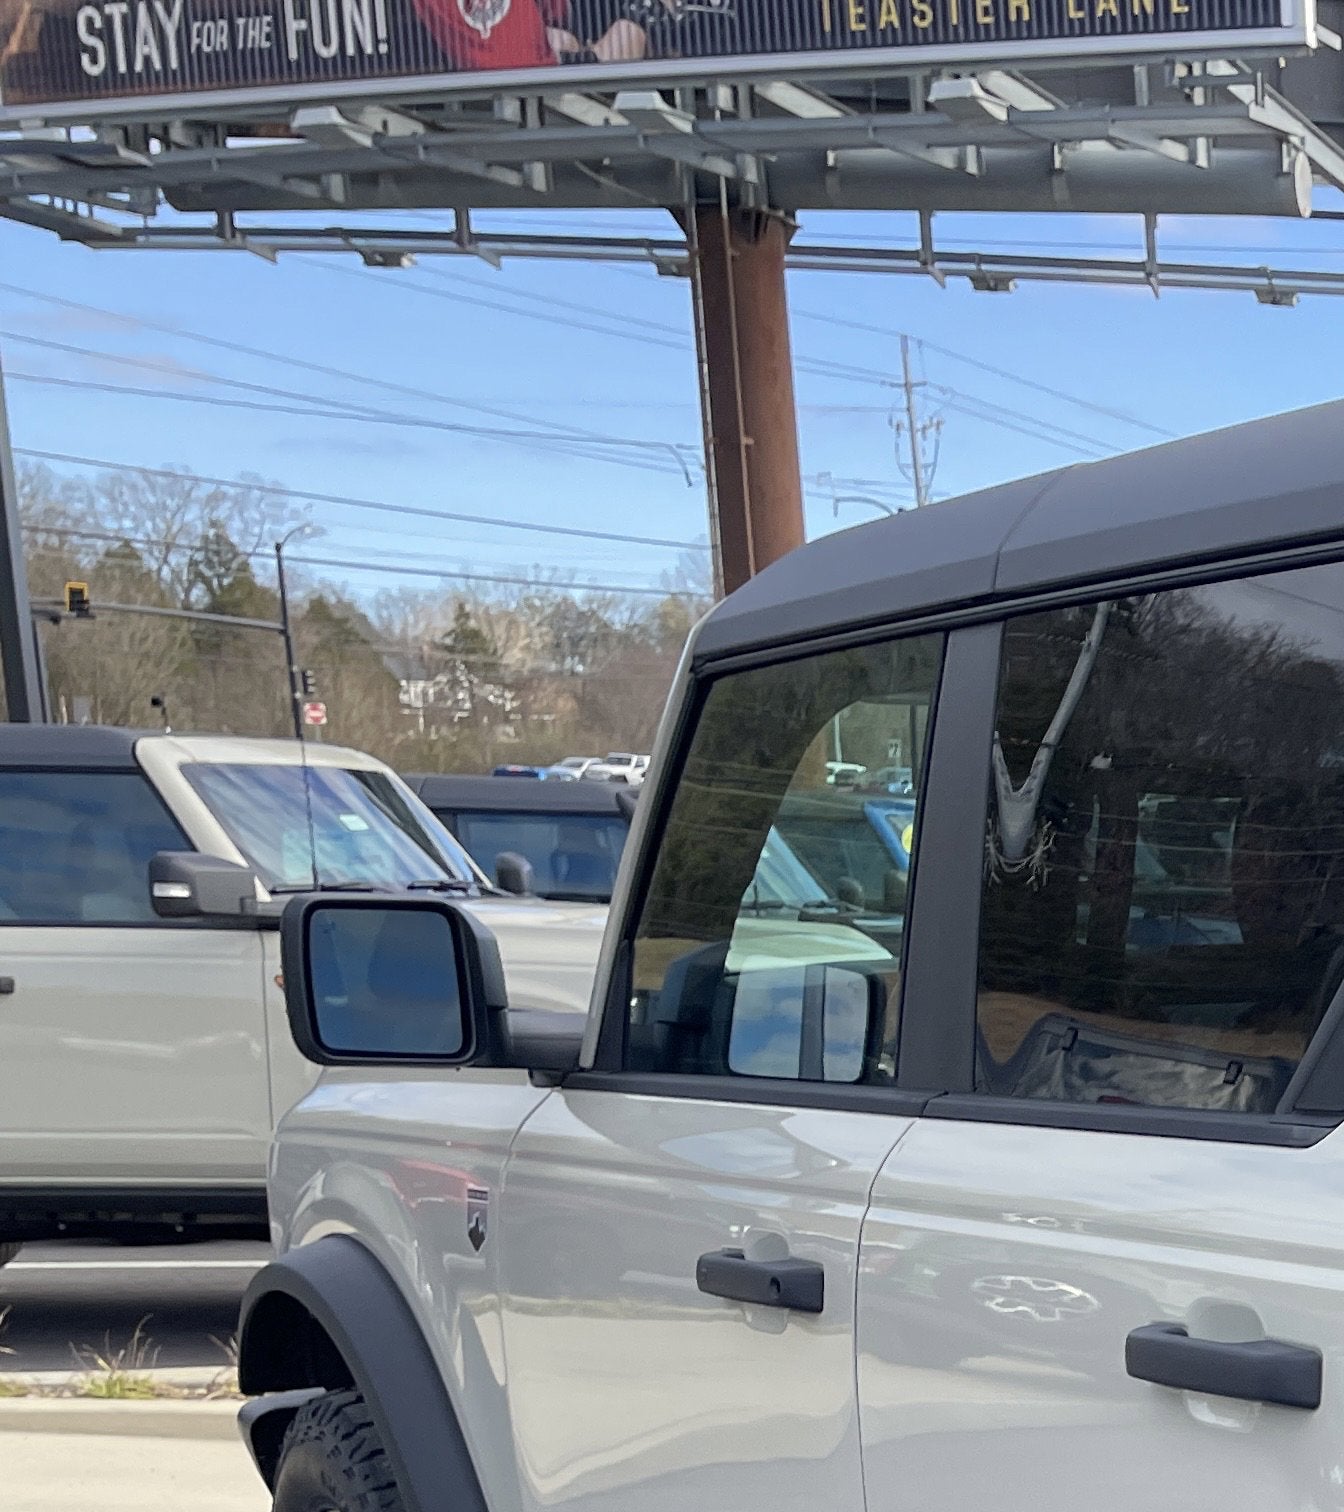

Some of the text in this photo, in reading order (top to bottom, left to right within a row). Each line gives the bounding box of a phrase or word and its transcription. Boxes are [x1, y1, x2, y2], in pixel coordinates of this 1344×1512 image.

[77, 0, 388, 76] STAY FOR THE FUN!
